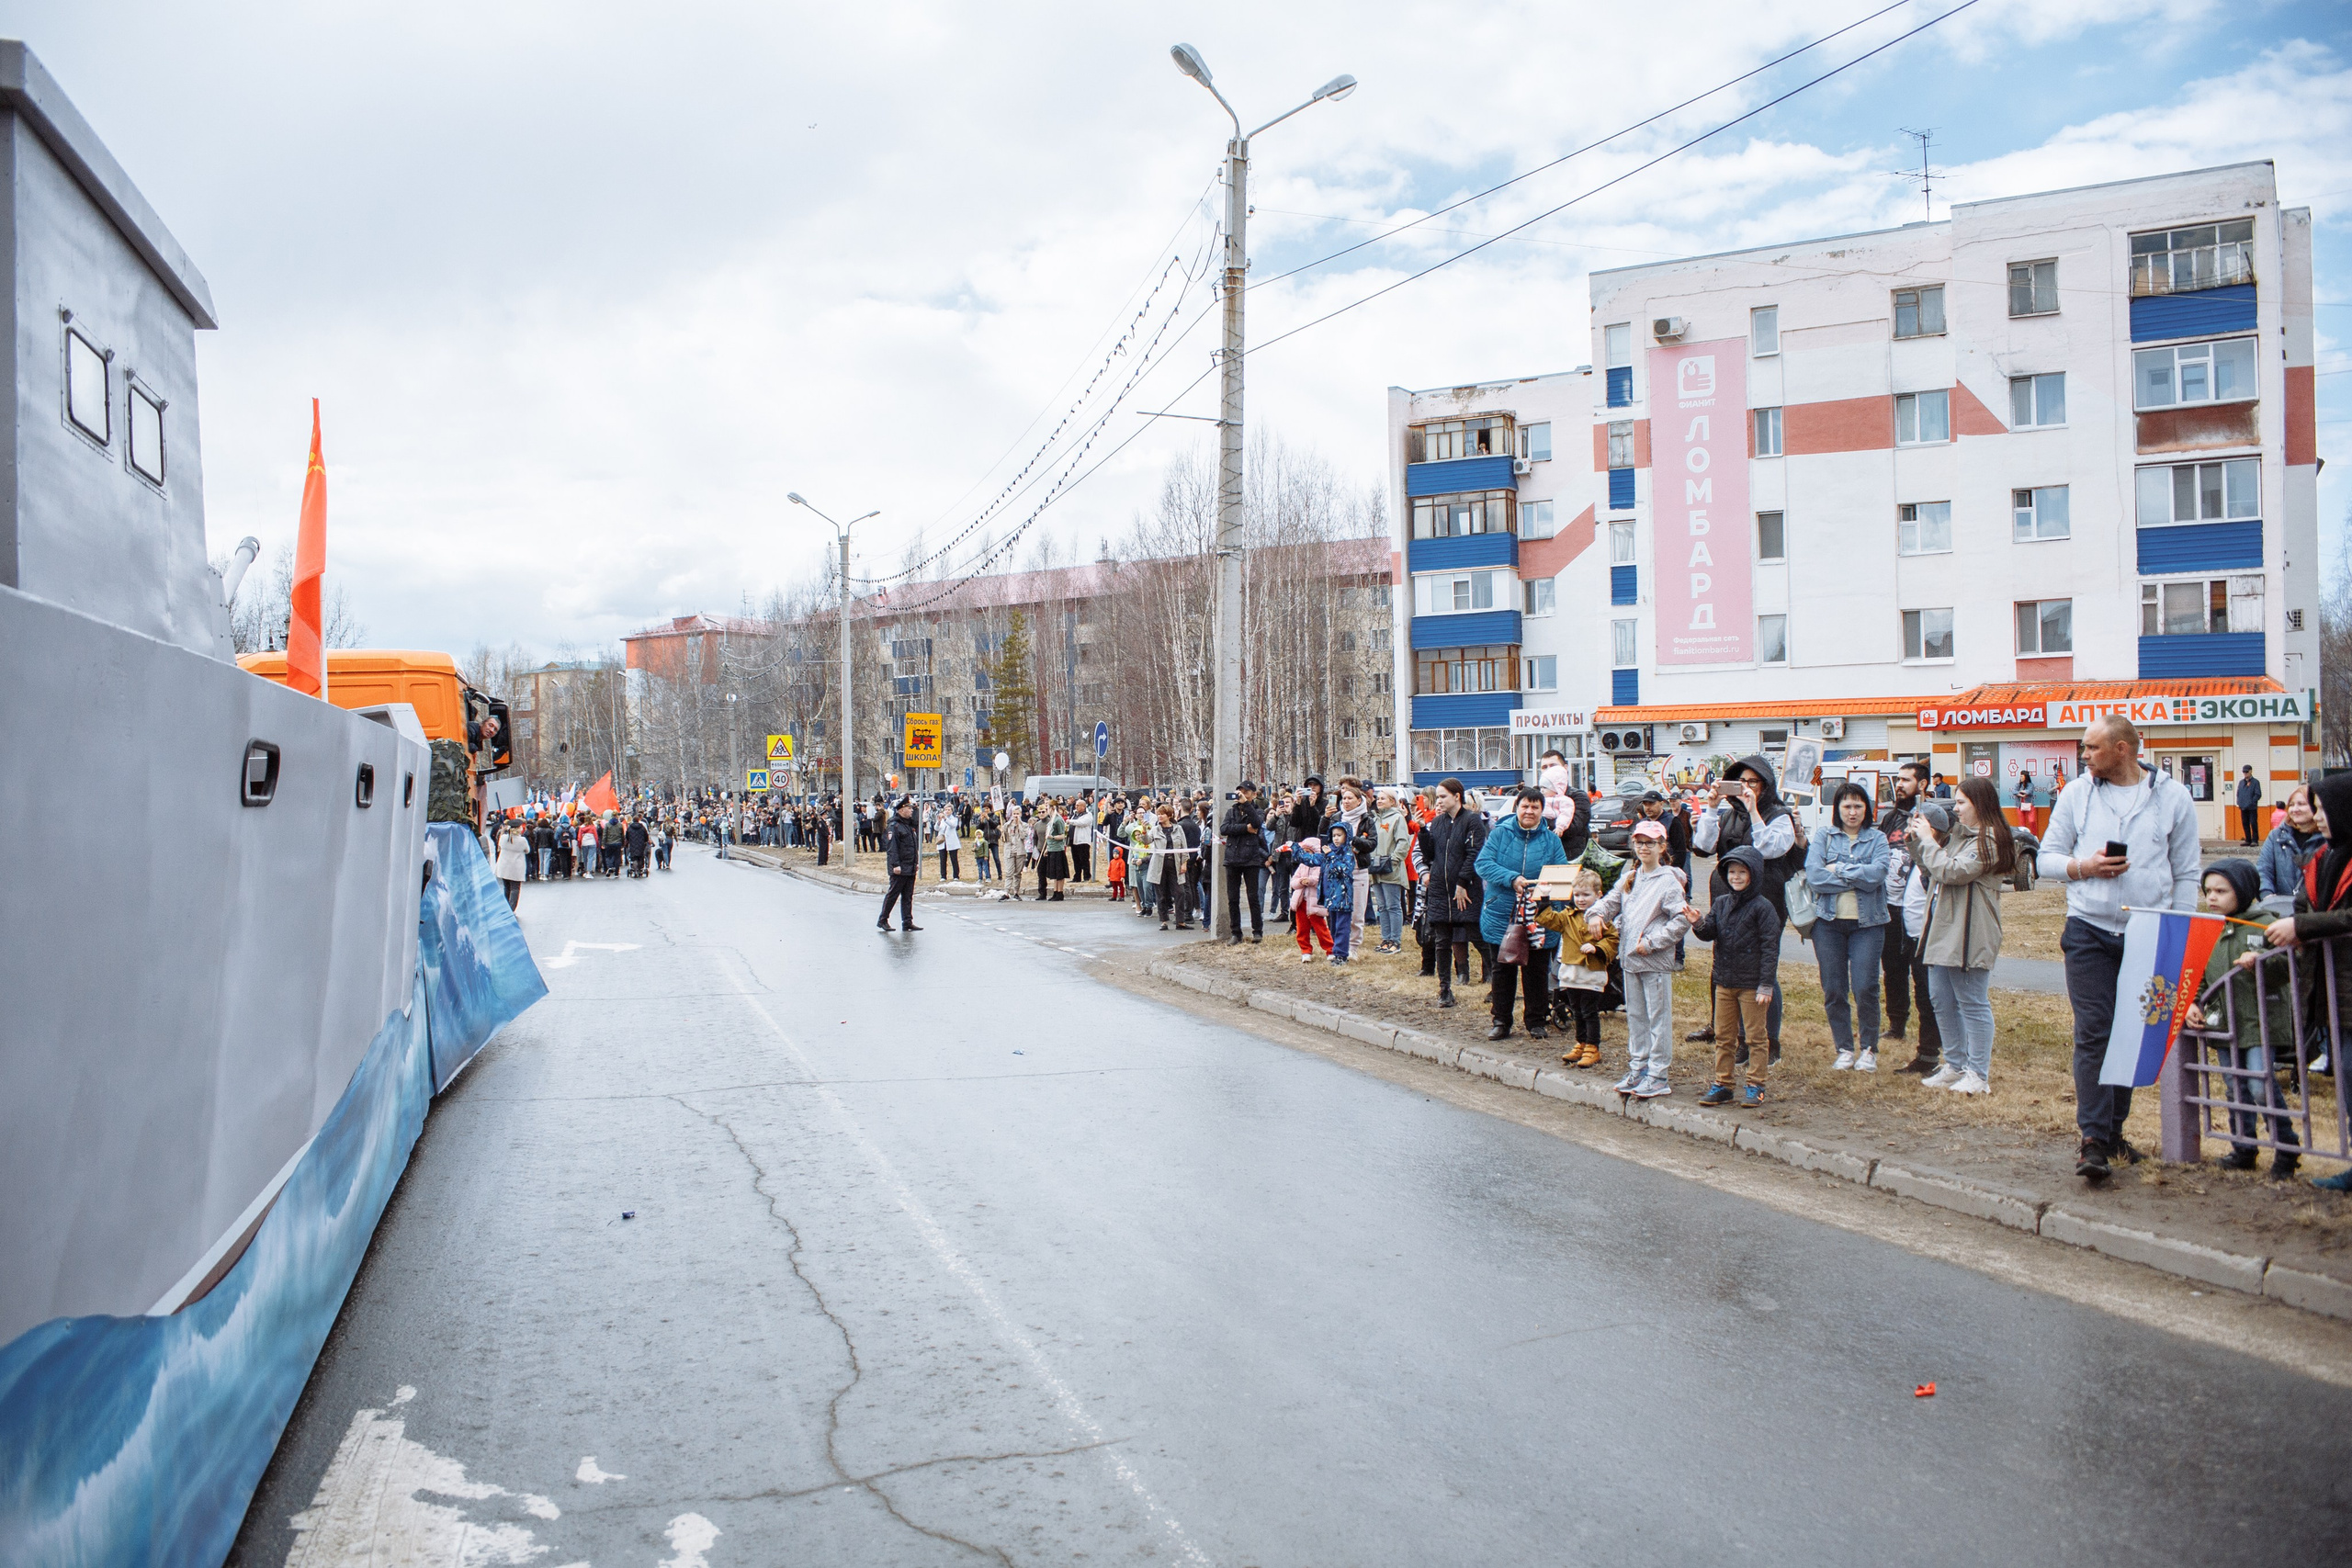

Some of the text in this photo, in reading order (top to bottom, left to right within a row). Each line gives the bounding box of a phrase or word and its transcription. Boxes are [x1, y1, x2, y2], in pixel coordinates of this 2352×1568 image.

[1678, 398, 1716, 409] ФИАНИТ
[1685, 415, 1716, 630] ЛОМБАРД
[1673, 644, 1740, 655] fianitlombard.ru
[2200, 698, 2301, 719] ЭКОНА
[906, 717, 928, 726] Сбрось
[1515, 712, 1584, 728] ПРОДУКТЫ
[1940, 707, 2045, 726] ЛОМБАРД
[906, 753, 941, 761] ШКОЛА!
[775, 775, 786, 784] 40
